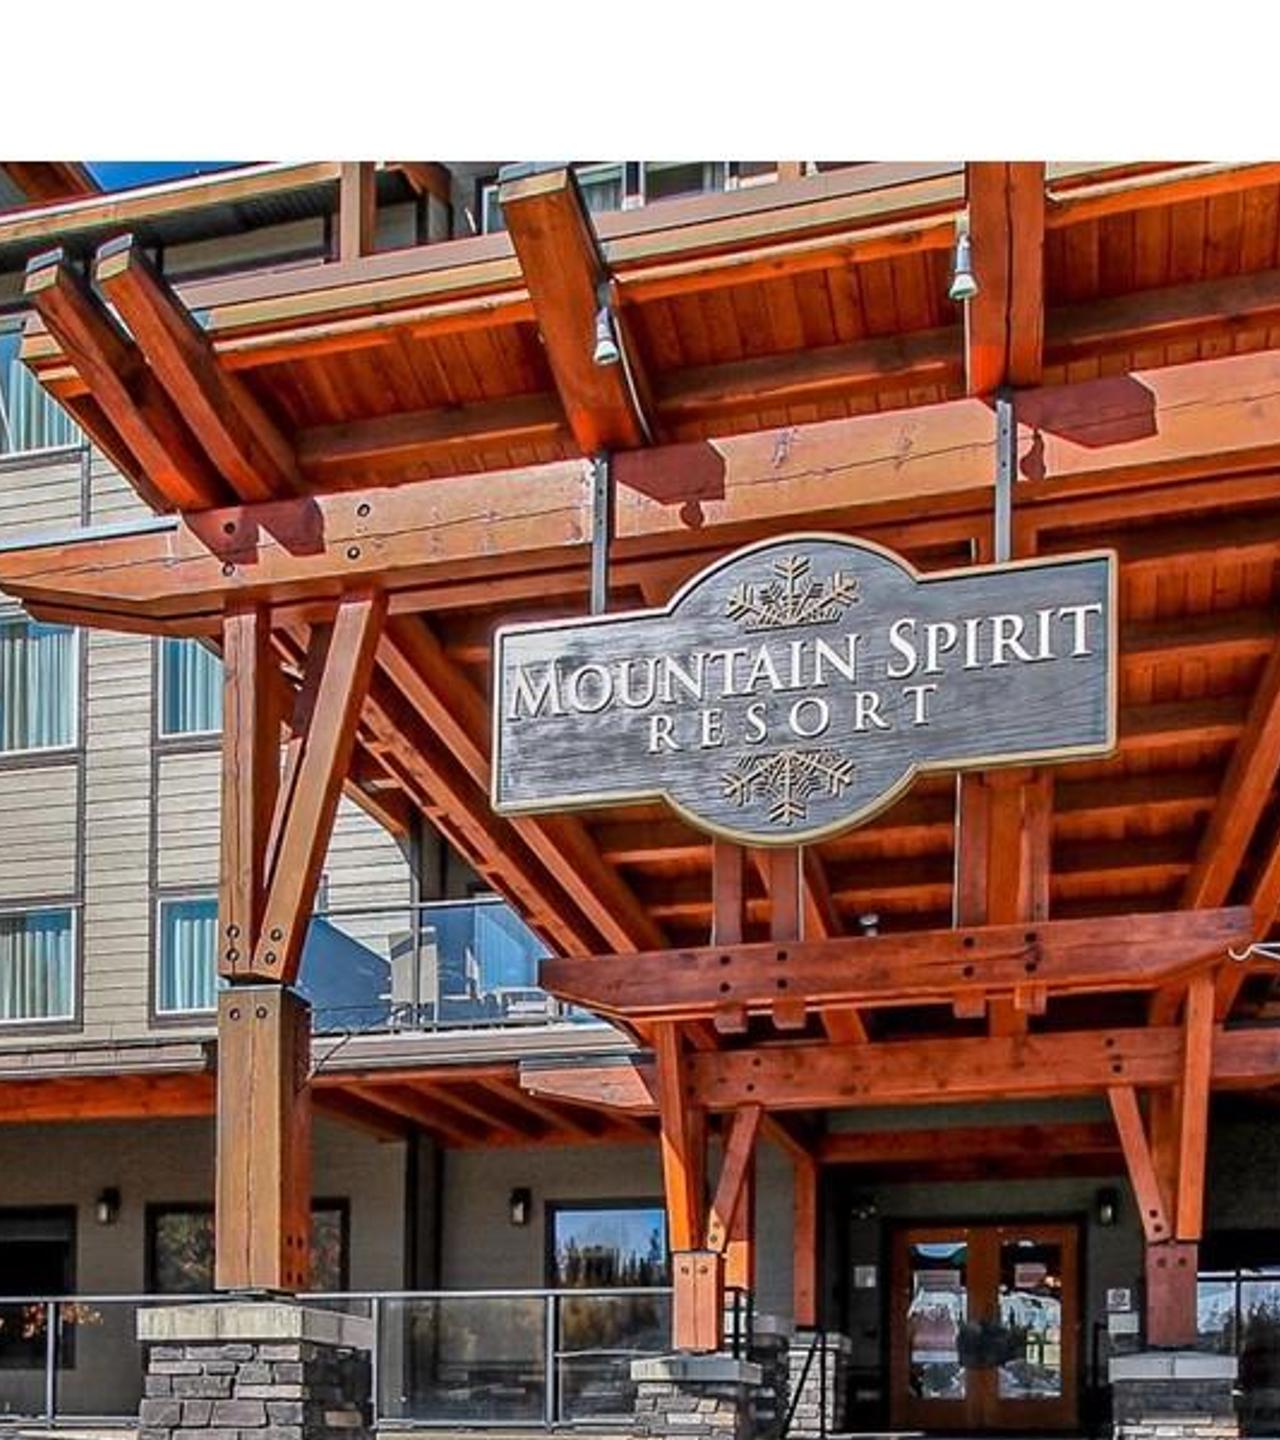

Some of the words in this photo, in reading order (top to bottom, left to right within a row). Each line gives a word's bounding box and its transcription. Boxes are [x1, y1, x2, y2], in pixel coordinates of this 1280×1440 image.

[507, 632, 862, 722] MOUNTAIN
[887, 603, 1104, 681] SPIRIT
[647, 684, 938, 755] RESORT
